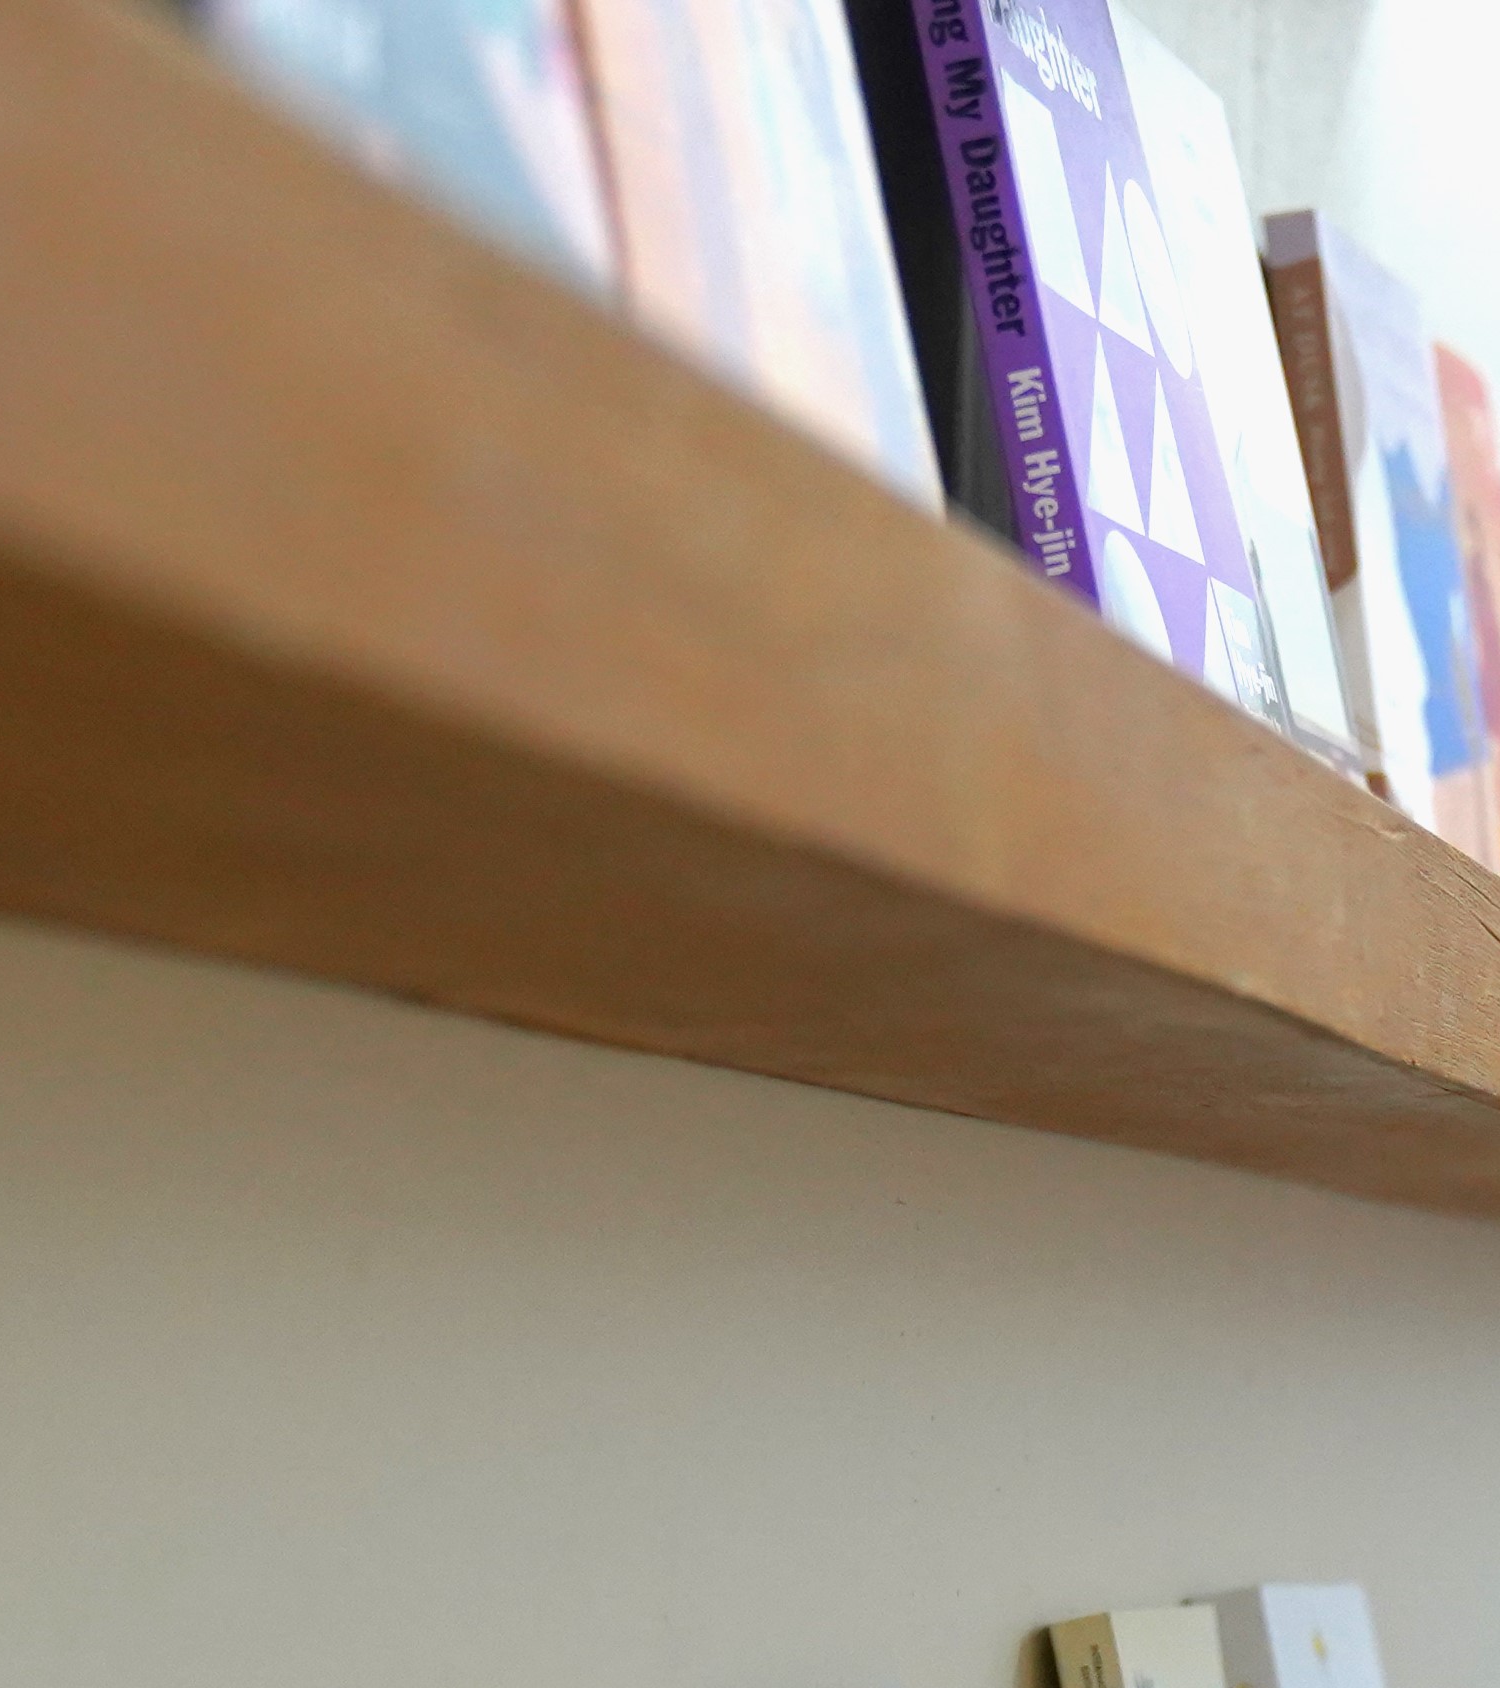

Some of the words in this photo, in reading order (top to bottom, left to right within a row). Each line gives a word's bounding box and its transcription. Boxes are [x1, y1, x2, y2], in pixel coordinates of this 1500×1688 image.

[945, 57, 987, 121] My
[959, 136, 1028, 339] Daughter
[1007, 366, 1048, 442] Kim
[1024, 450, 1076, 578] Hye-jin
